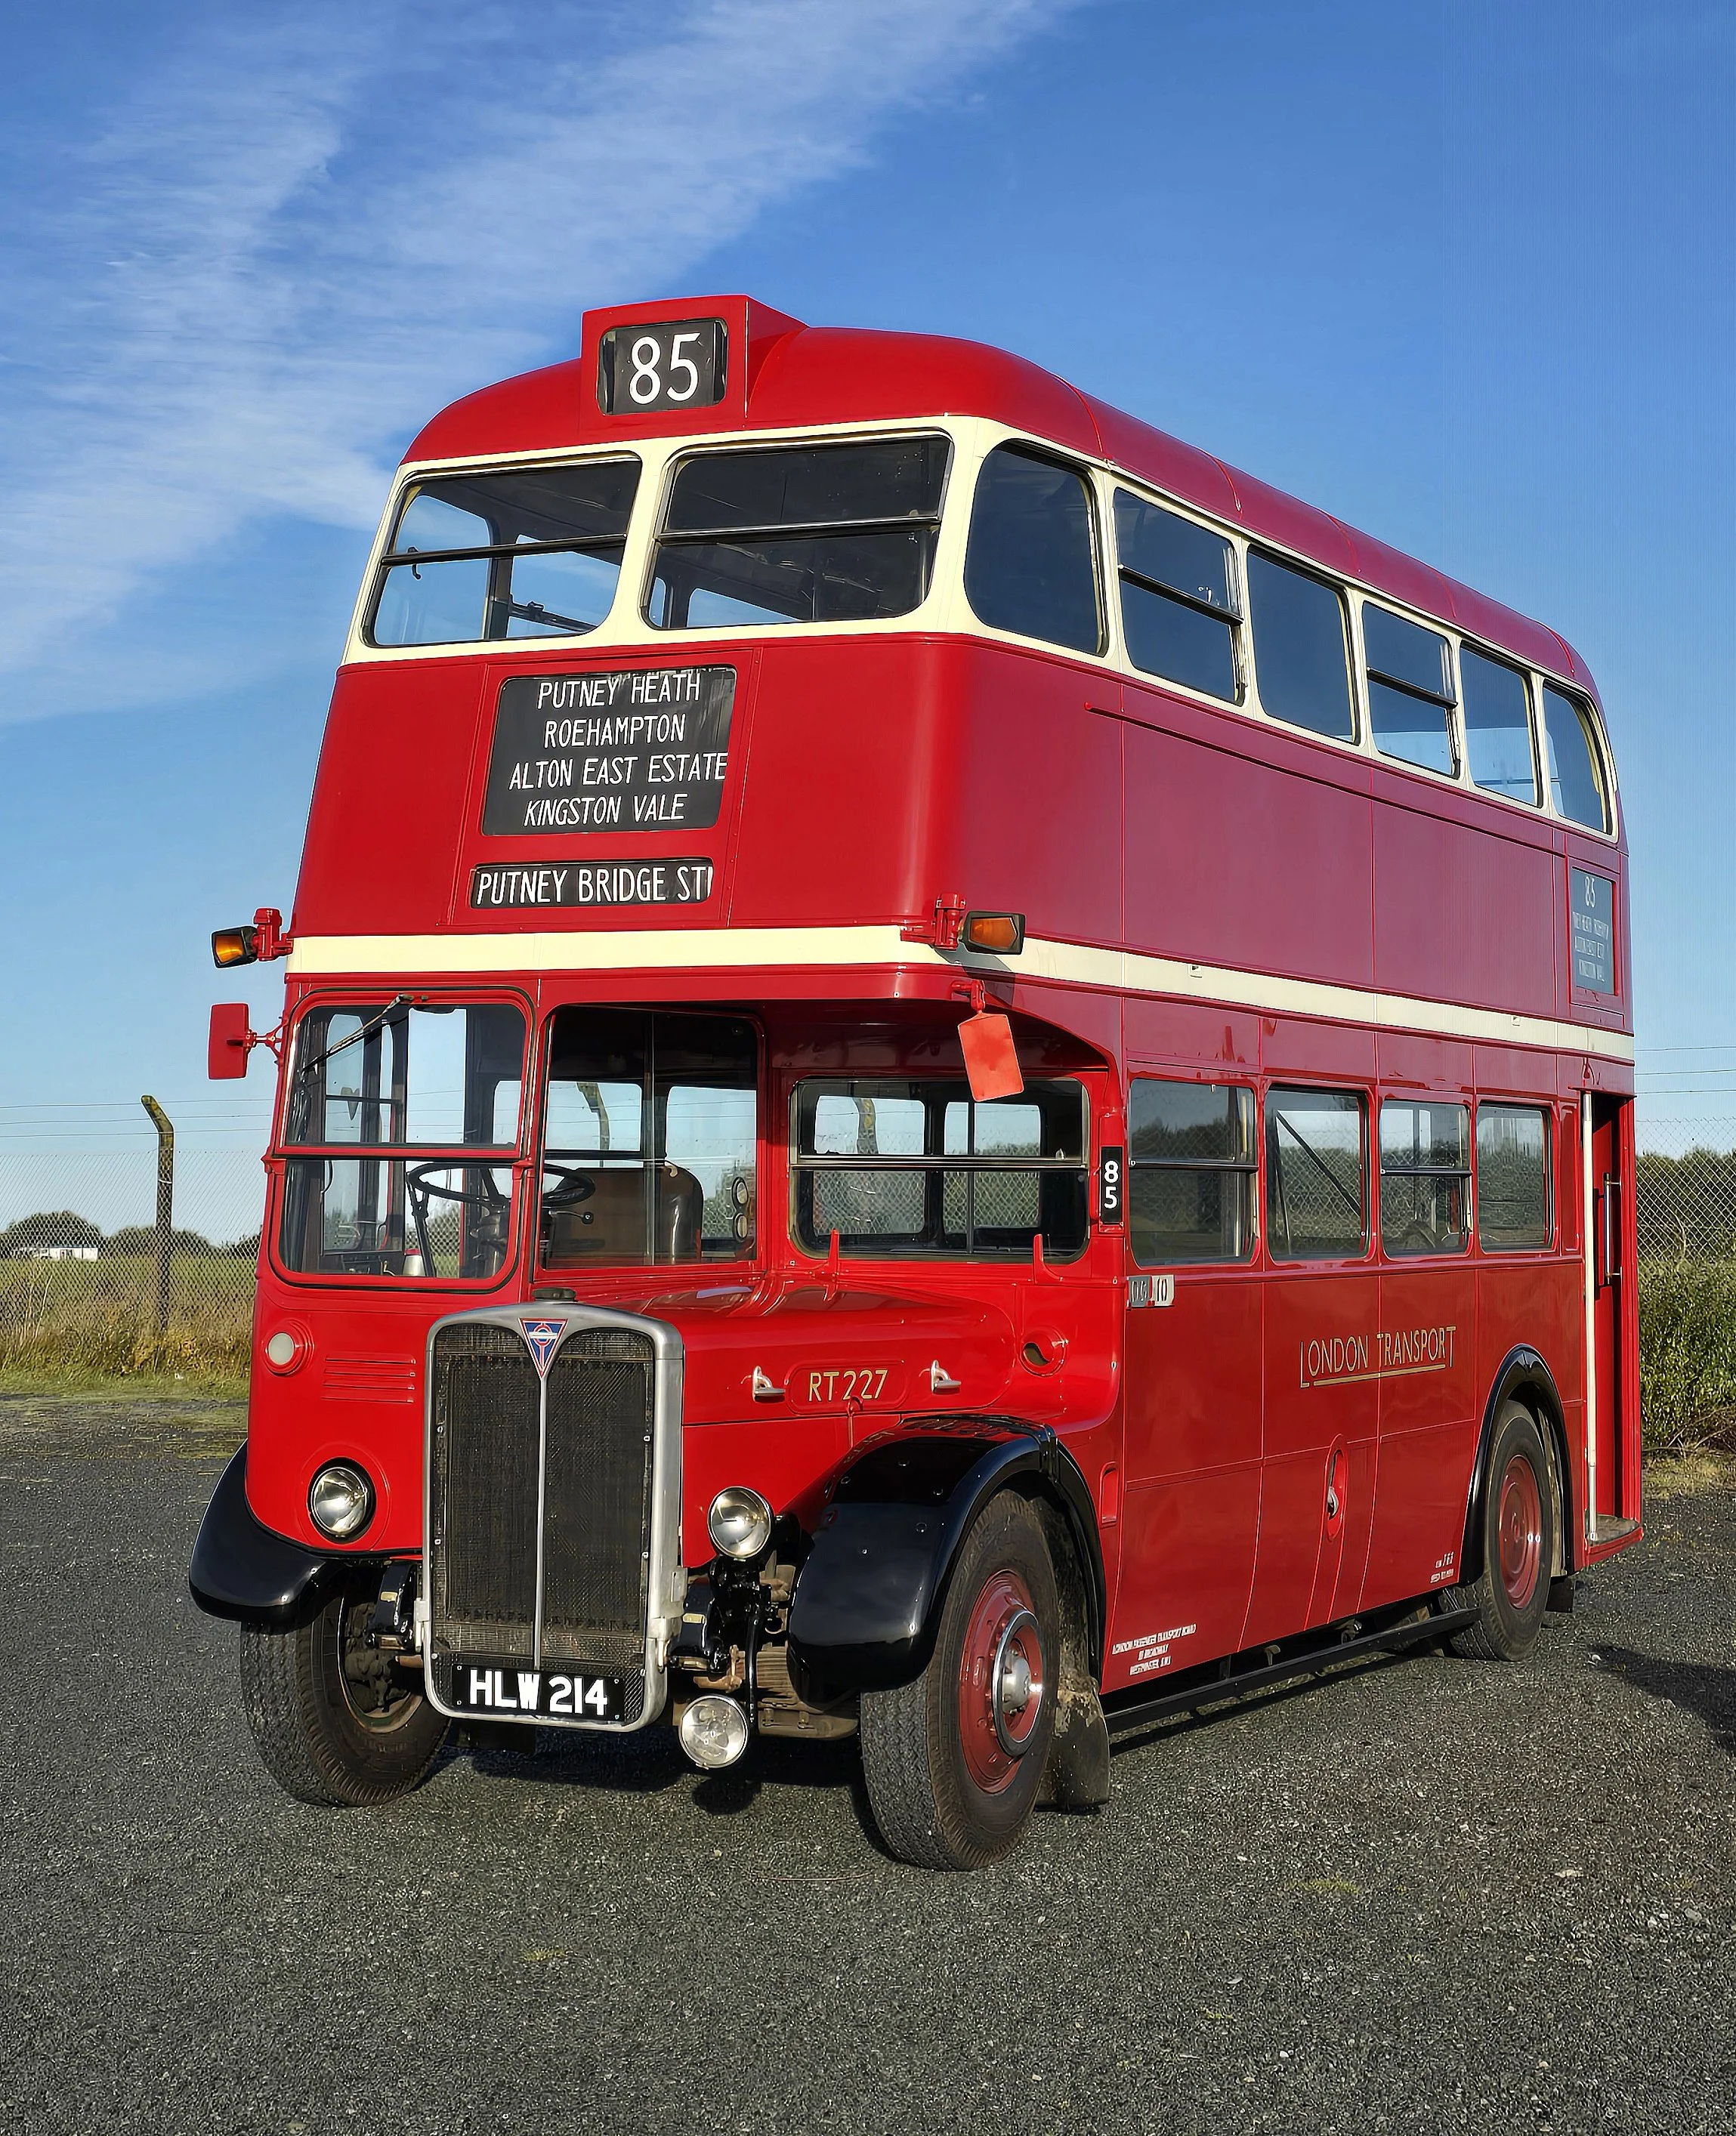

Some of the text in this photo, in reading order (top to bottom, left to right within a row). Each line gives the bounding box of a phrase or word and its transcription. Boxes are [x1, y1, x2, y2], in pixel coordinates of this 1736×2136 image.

[629, 332, 701, 405] 85
[537, 672, 701, 710] PUTNEY HEATH
[544, 714, 686, 749] ROEHAMPTON
[508, 752, 729, 790] ALTON EAST ESTATE
[524, 793, 688, 826] KINGSTON VALE
[477, 869, 568, 905] PUTNEY
[578, 867, 666, 903] BRIDGE
[1104, 1160, 1120, 1209] 85
[1300, 1326, 1456, 1388] LONDON TRANSPORT
[808, 1369, 888, 1402] RT 227
[470, 1668, 609, 1717] HLW 214
